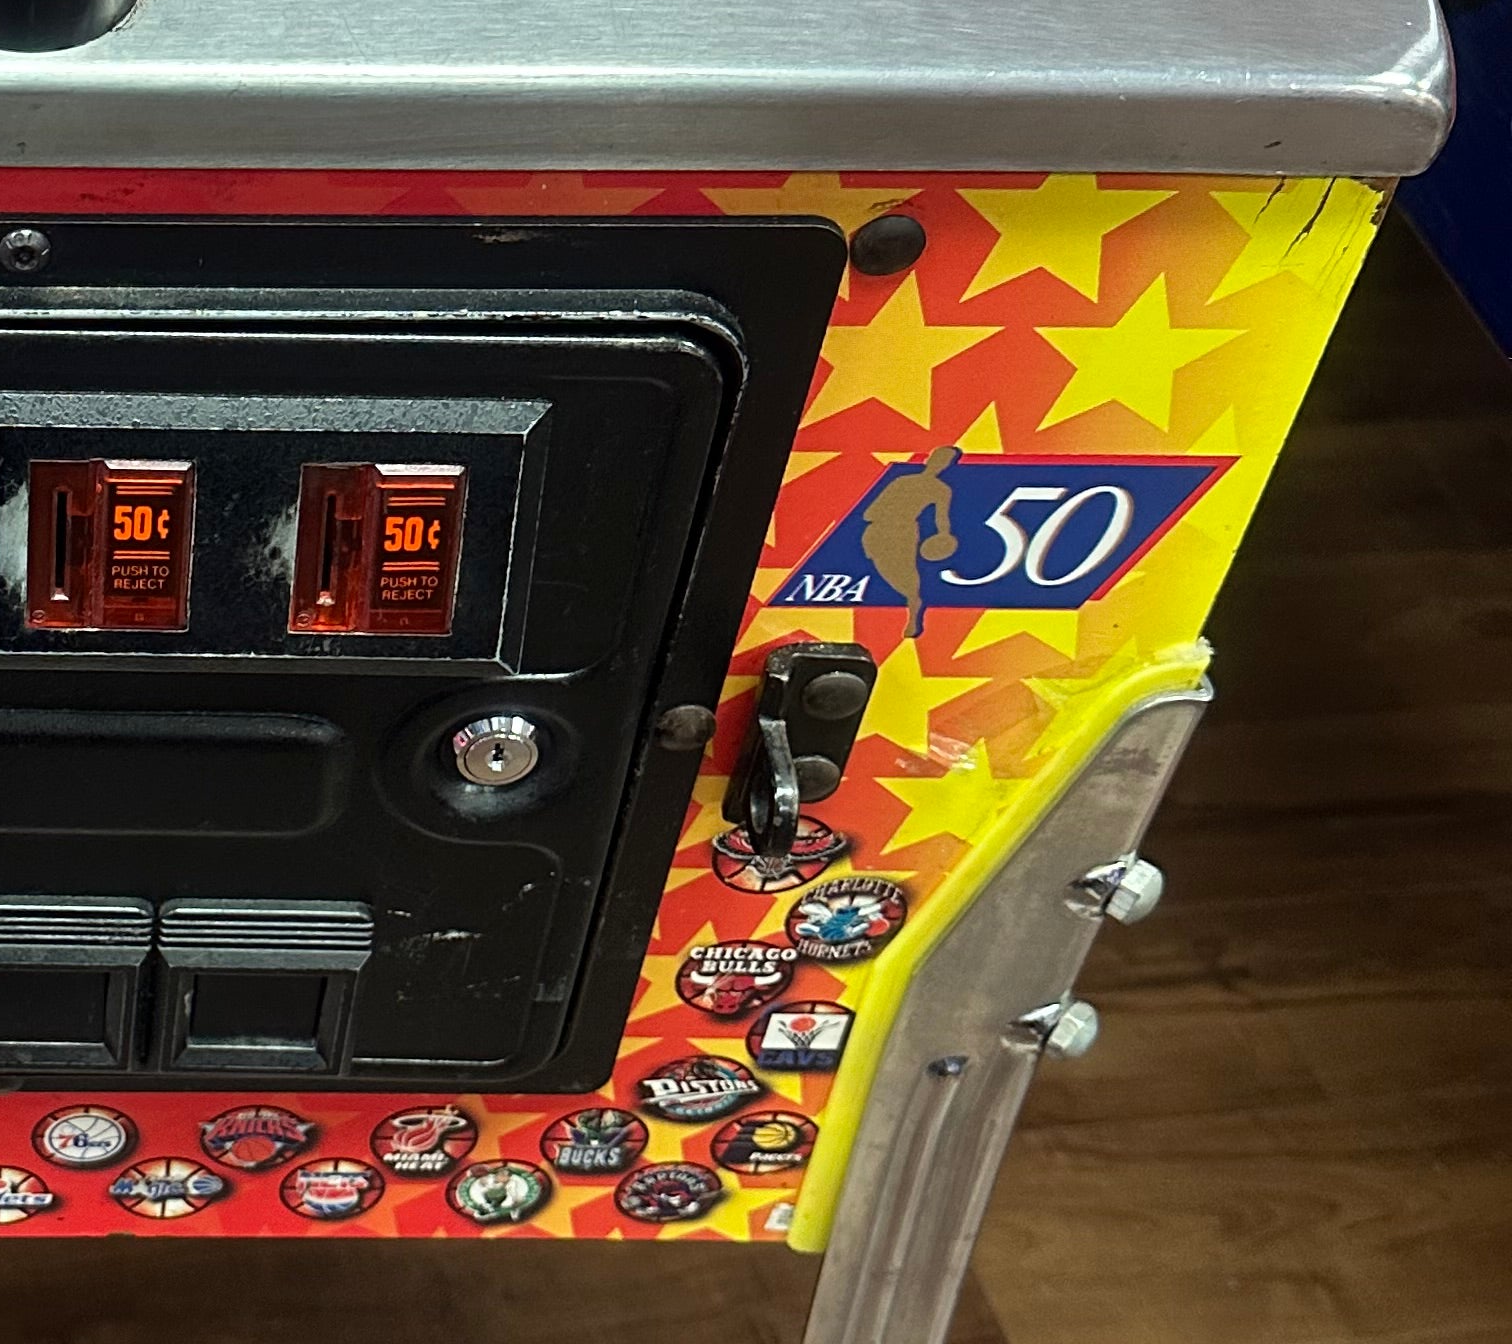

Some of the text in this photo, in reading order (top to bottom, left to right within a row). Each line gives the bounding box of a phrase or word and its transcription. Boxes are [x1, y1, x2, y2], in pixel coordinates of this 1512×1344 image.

[113, 505, 170, 541] 50¢
[383, 516, 441, 553] 50¢
[940, 485, 1134, 586] 50
[111, 564, 170, 578] PUSH TO
[113, 577, 165, 591] REJECT
[380, 575, 438, 589] PUSH TO
[785, 573, 870, 603] NBA
[381, 588, 434, 602] REJECT
[802, 877, 904, 904] CHARLOTTE
[690, 947, 798, 961] CHICAGO
[798, 939, 872, 959] HORNETS
[702, 960, 777, 973] BULLS
[644, 1078, 761, 1097] PISTONS
[206, 1116, 306, 1140] KNICKS
[383, 1153, 448, 1162] MIAMI
[395, 1161, 442, 1171] HEAT
[556, 1146, 621, 1167] BUCKS
